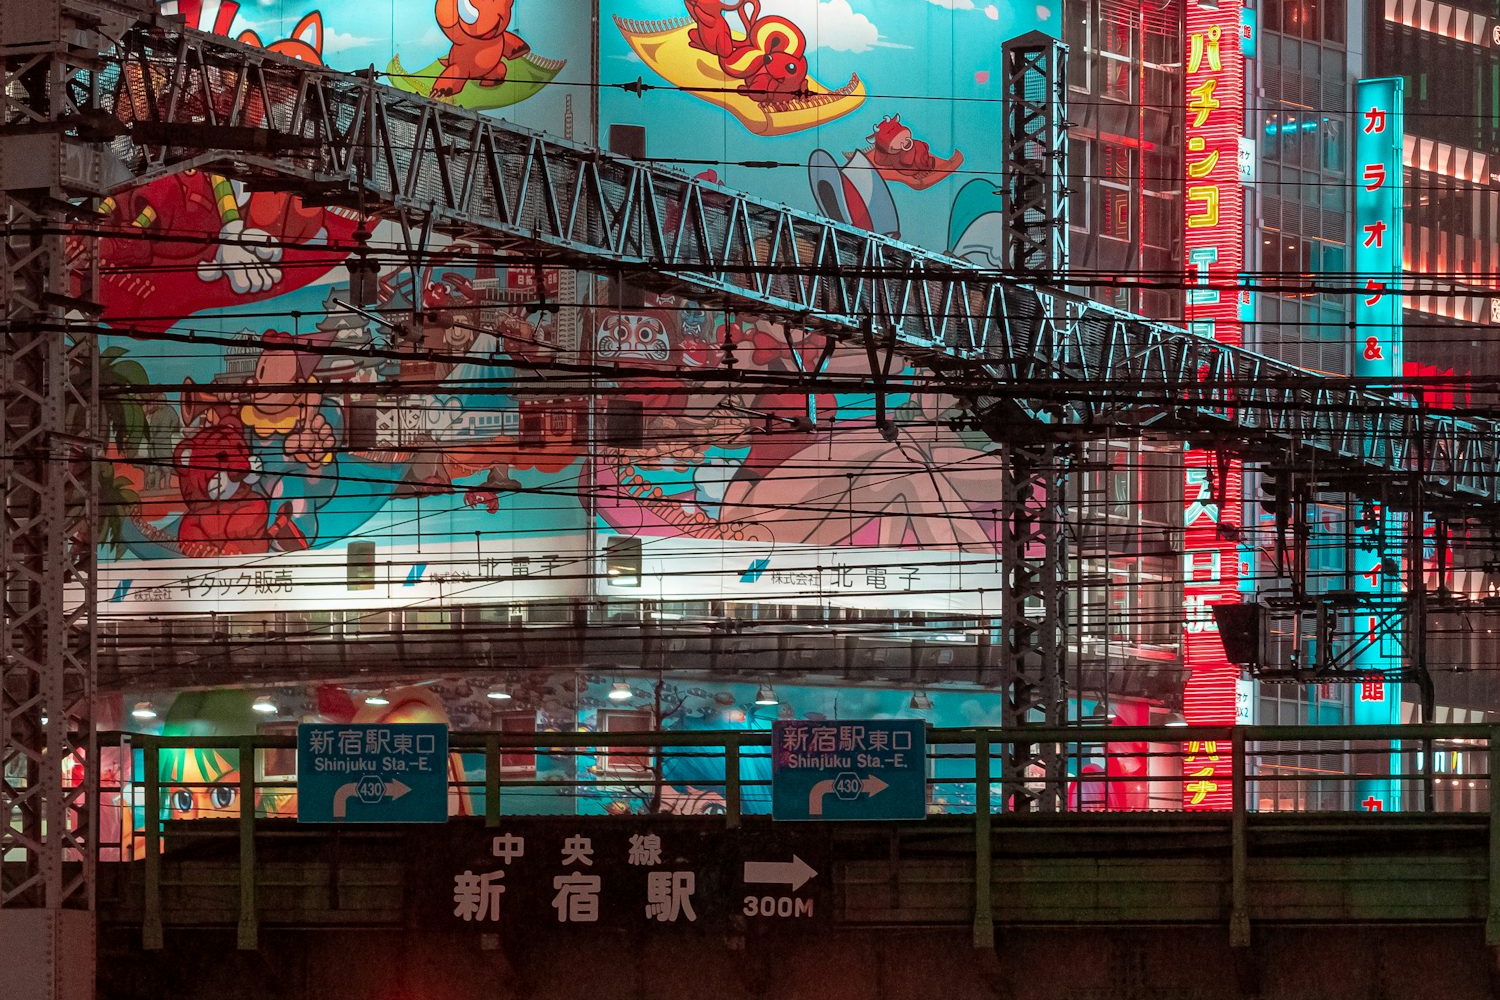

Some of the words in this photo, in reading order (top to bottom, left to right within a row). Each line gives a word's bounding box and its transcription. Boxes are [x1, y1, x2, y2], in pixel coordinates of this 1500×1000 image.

[181, 568, 293, 598] キタック販売
[831, 562, 921, 591] 北電子
[309, 728, 436, 756] 新宿駅東口
[783, 725, 912, 752] 新宿駅東口
[314, 757, 377, 774] Shinjuku
[788, 753, 851, 771] Shinjuku
[360, 782, 382, 799] 430
[836, 779, 859, 795] 430
[493, 833, 662, 867] 中央線
[454, 869, 697, 923] 新宿駅
[743, 896, 814, 918] 300M
